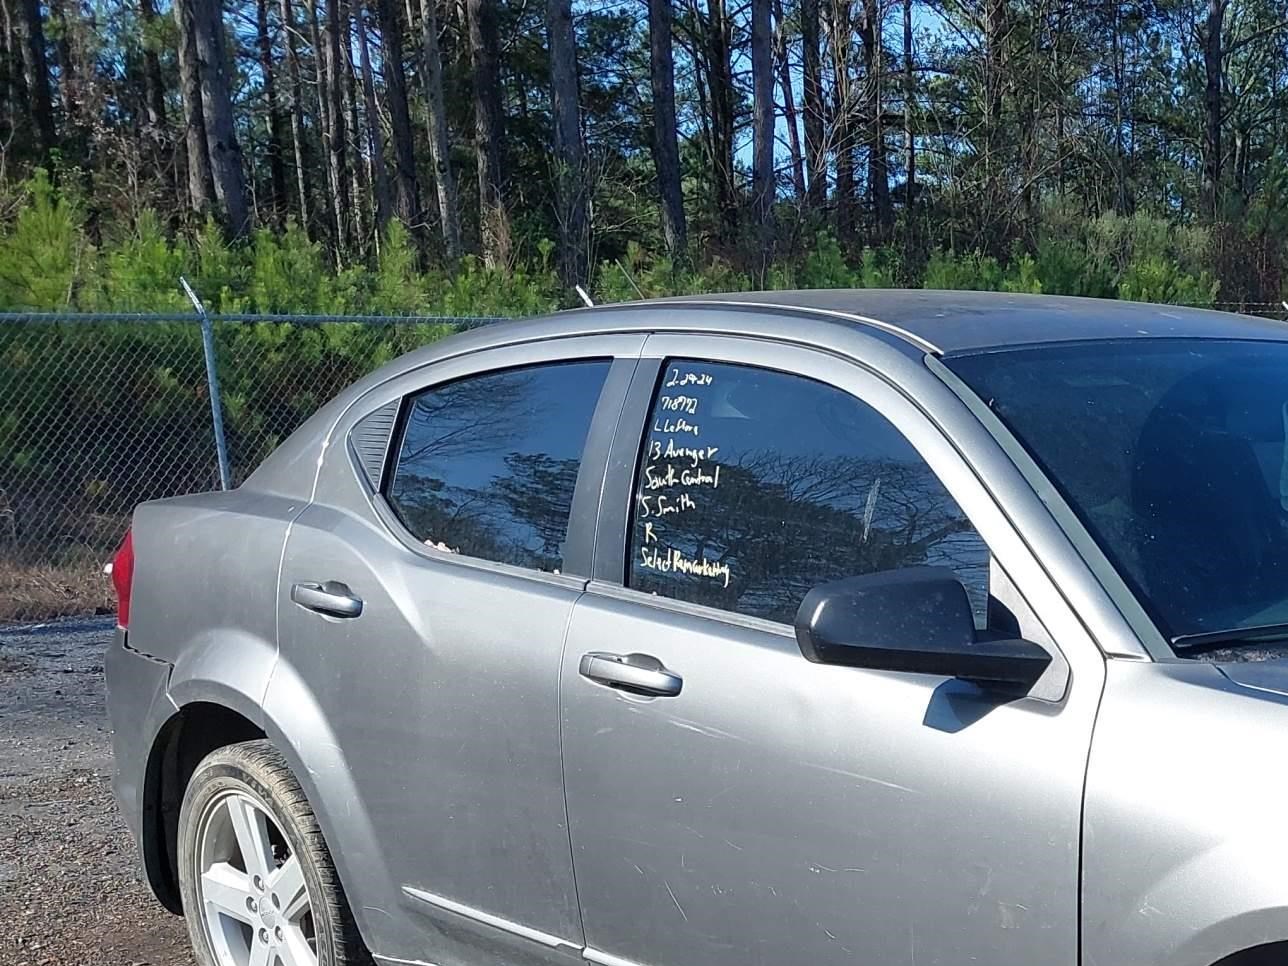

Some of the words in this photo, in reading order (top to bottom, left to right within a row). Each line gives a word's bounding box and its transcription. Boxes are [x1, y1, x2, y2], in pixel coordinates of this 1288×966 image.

[648, 440, 662, 460] 13
[663, 438, 719, 468] Avenger
[645, 463, 680, 490] South
[681, 465, 720, 489] Central
[645, 521, 658, 544] R
